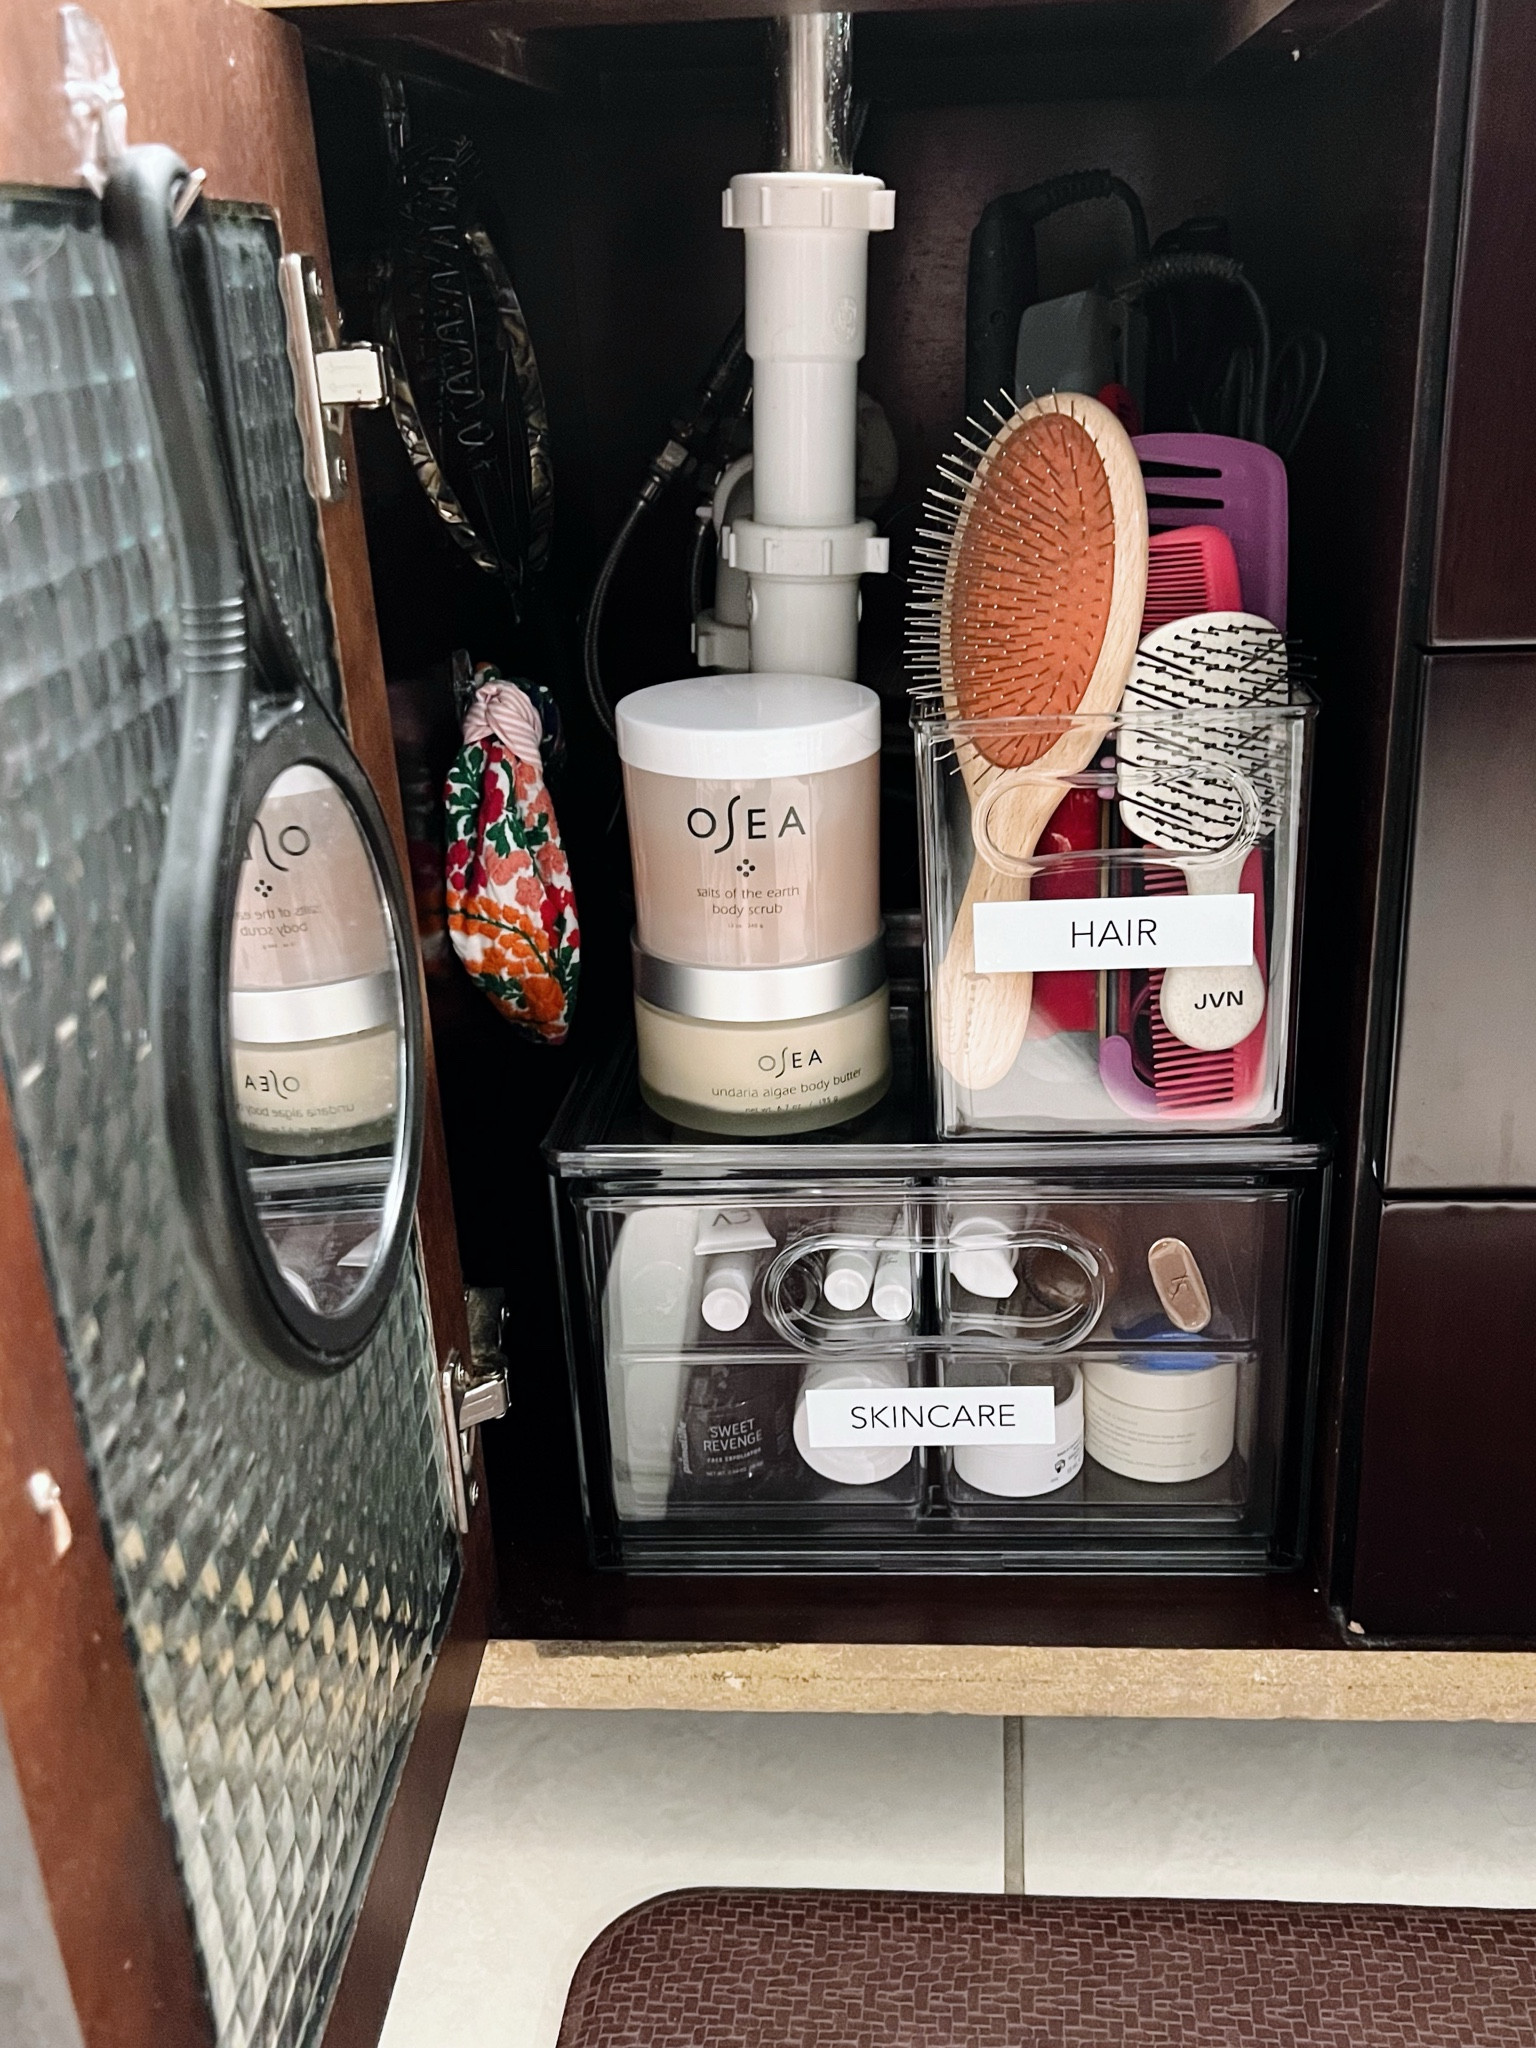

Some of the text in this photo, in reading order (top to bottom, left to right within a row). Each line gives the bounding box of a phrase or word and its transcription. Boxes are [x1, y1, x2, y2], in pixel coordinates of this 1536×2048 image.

[687, 795, 806, 854] OSEA
[696, 885, 800, 899] salts of the earth
[712, 903, 783, 918] body scrub
[1071, 918, 1158, 948] HAIR
[1194, 990, 1244, 1010] JVN
[758, 1047, 823, 1078] OSEA
[711, 1068, 862, 1099] undaria algae body butter
[710, 1418, 755, 1438] SWEET
[851, 1404, 1016, 1430] SKINCARE
[703, 1429, 763, 1452] REVENGE
